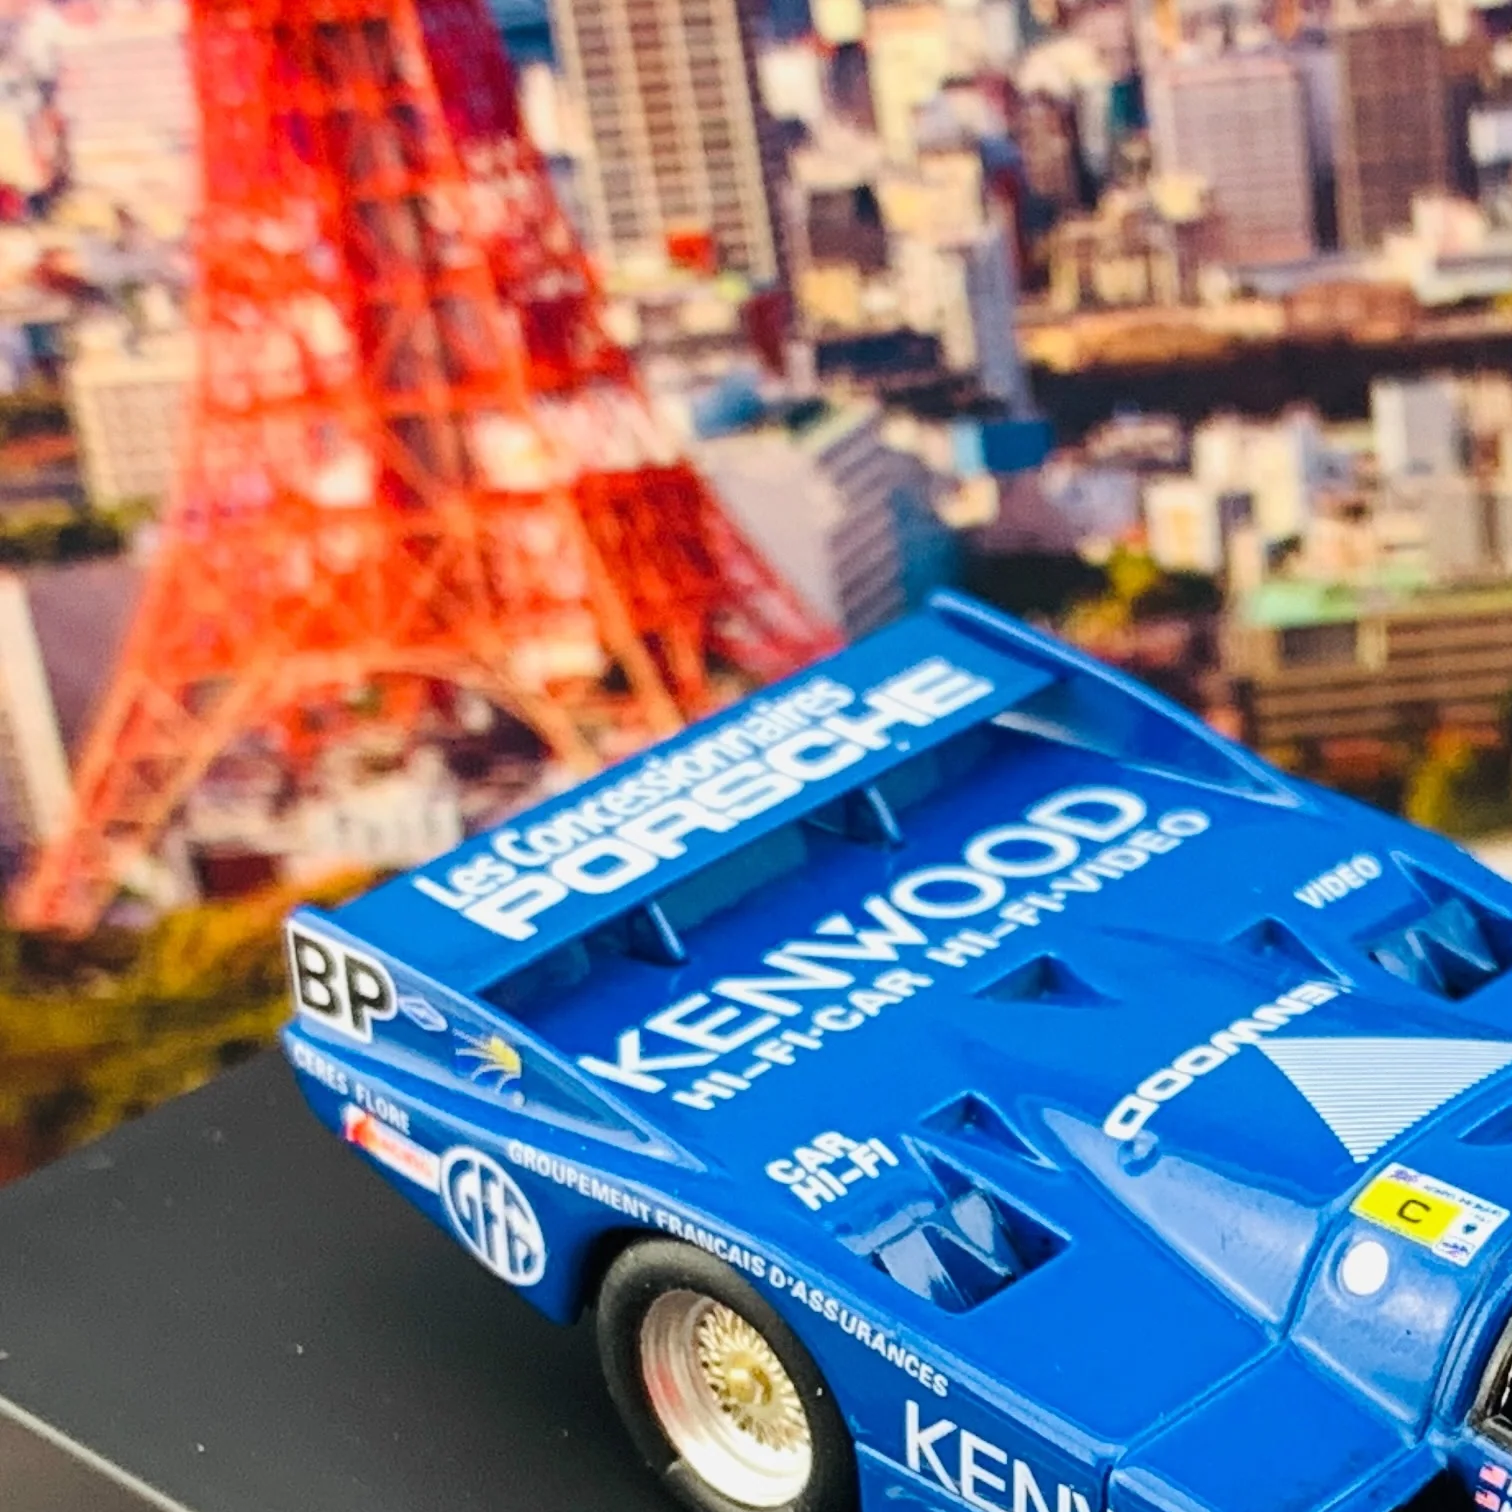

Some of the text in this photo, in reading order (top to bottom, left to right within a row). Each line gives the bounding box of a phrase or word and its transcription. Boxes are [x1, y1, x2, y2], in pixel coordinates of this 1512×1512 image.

[413, 676, 854, 910] Les Concessionnaires
[463, 656, 995, 942] PORSCHE
[1294, 854, 1381, 911] VIDEO
[293, 928, 393, 1033] BP
[577, 786, 1148, 1093] KENWOOD
[354, 1082, 412, 1137] FLORE
[766, 1130, 859, 1189] CAR
[792, 1136, 902, 1212] HI-FI
[1397, 1198, 1432, 1224] C
[507, 1140, 651, 1225] GROUPEMENT
[655, 1210, 767, 1281] FRANCAIS
[767, 1264, 950, 1399] D'ASSURANCES
